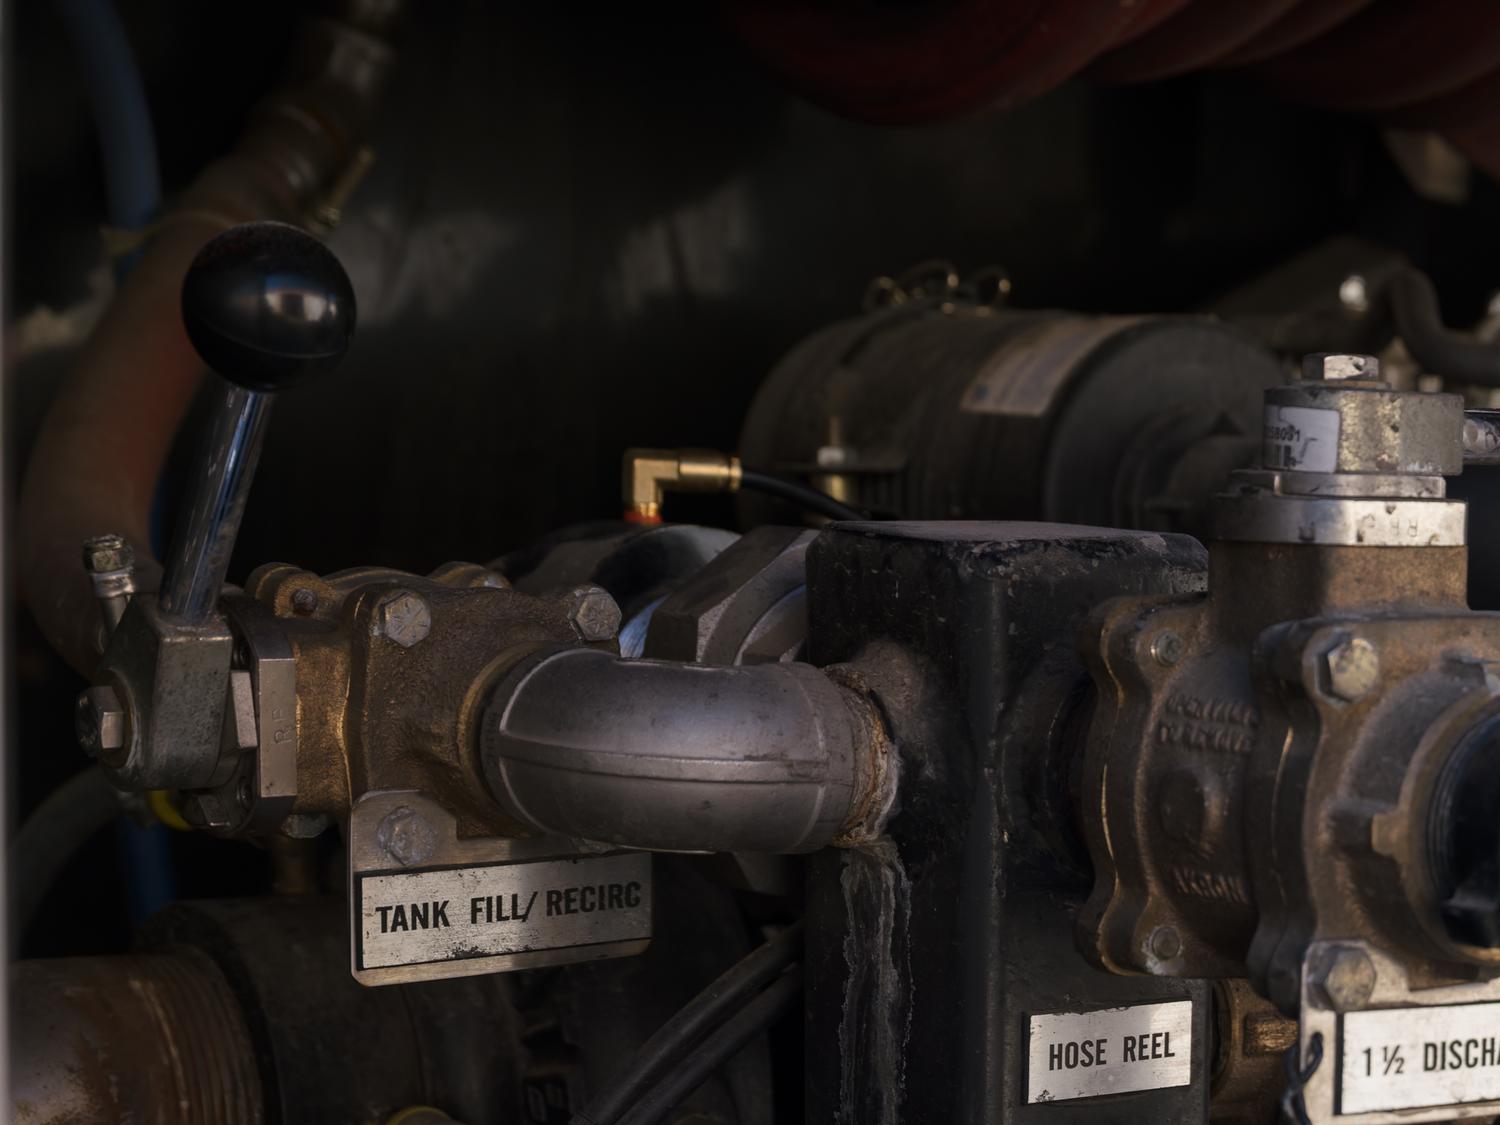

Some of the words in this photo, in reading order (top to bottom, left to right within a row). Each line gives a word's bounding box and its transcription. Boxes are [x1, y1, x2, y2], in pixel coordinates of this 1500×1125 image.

[375, 900, 450, 933] TANK
[1048, 1038, 1107, 1071] HOSE
[1122, 1032, 1175, 1062] REEL
[1362, 1047, 1372, 1076] 1
